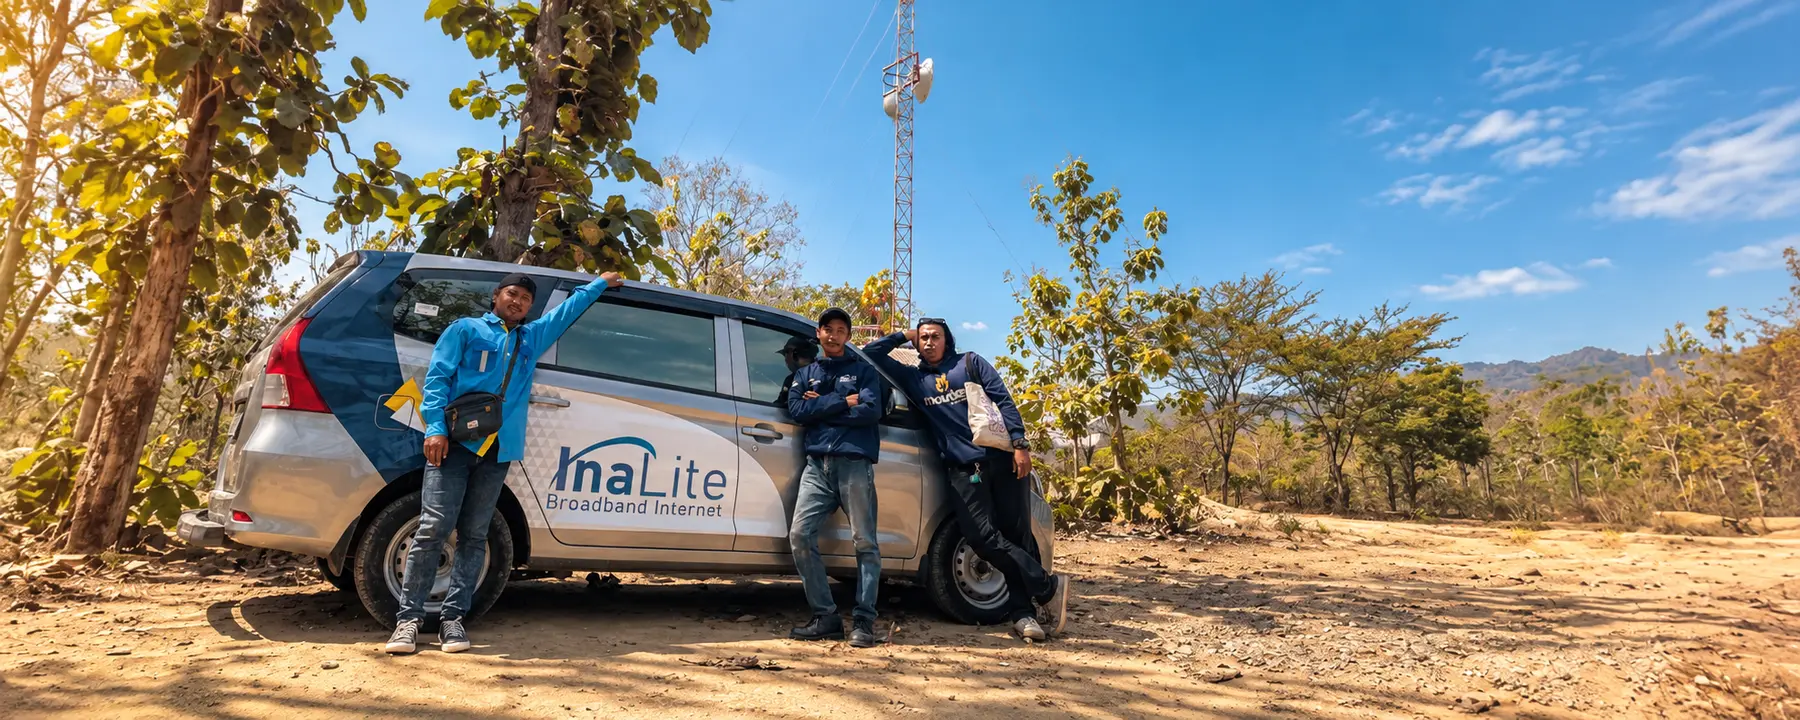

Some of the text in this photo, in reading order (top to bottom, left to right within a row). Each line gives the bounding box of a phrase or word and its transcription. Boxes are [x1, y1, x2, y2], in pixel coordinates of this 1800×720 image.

[552, 445, 727, 500] InaLite
[546, 493, 723, 517] Broadband Internet
